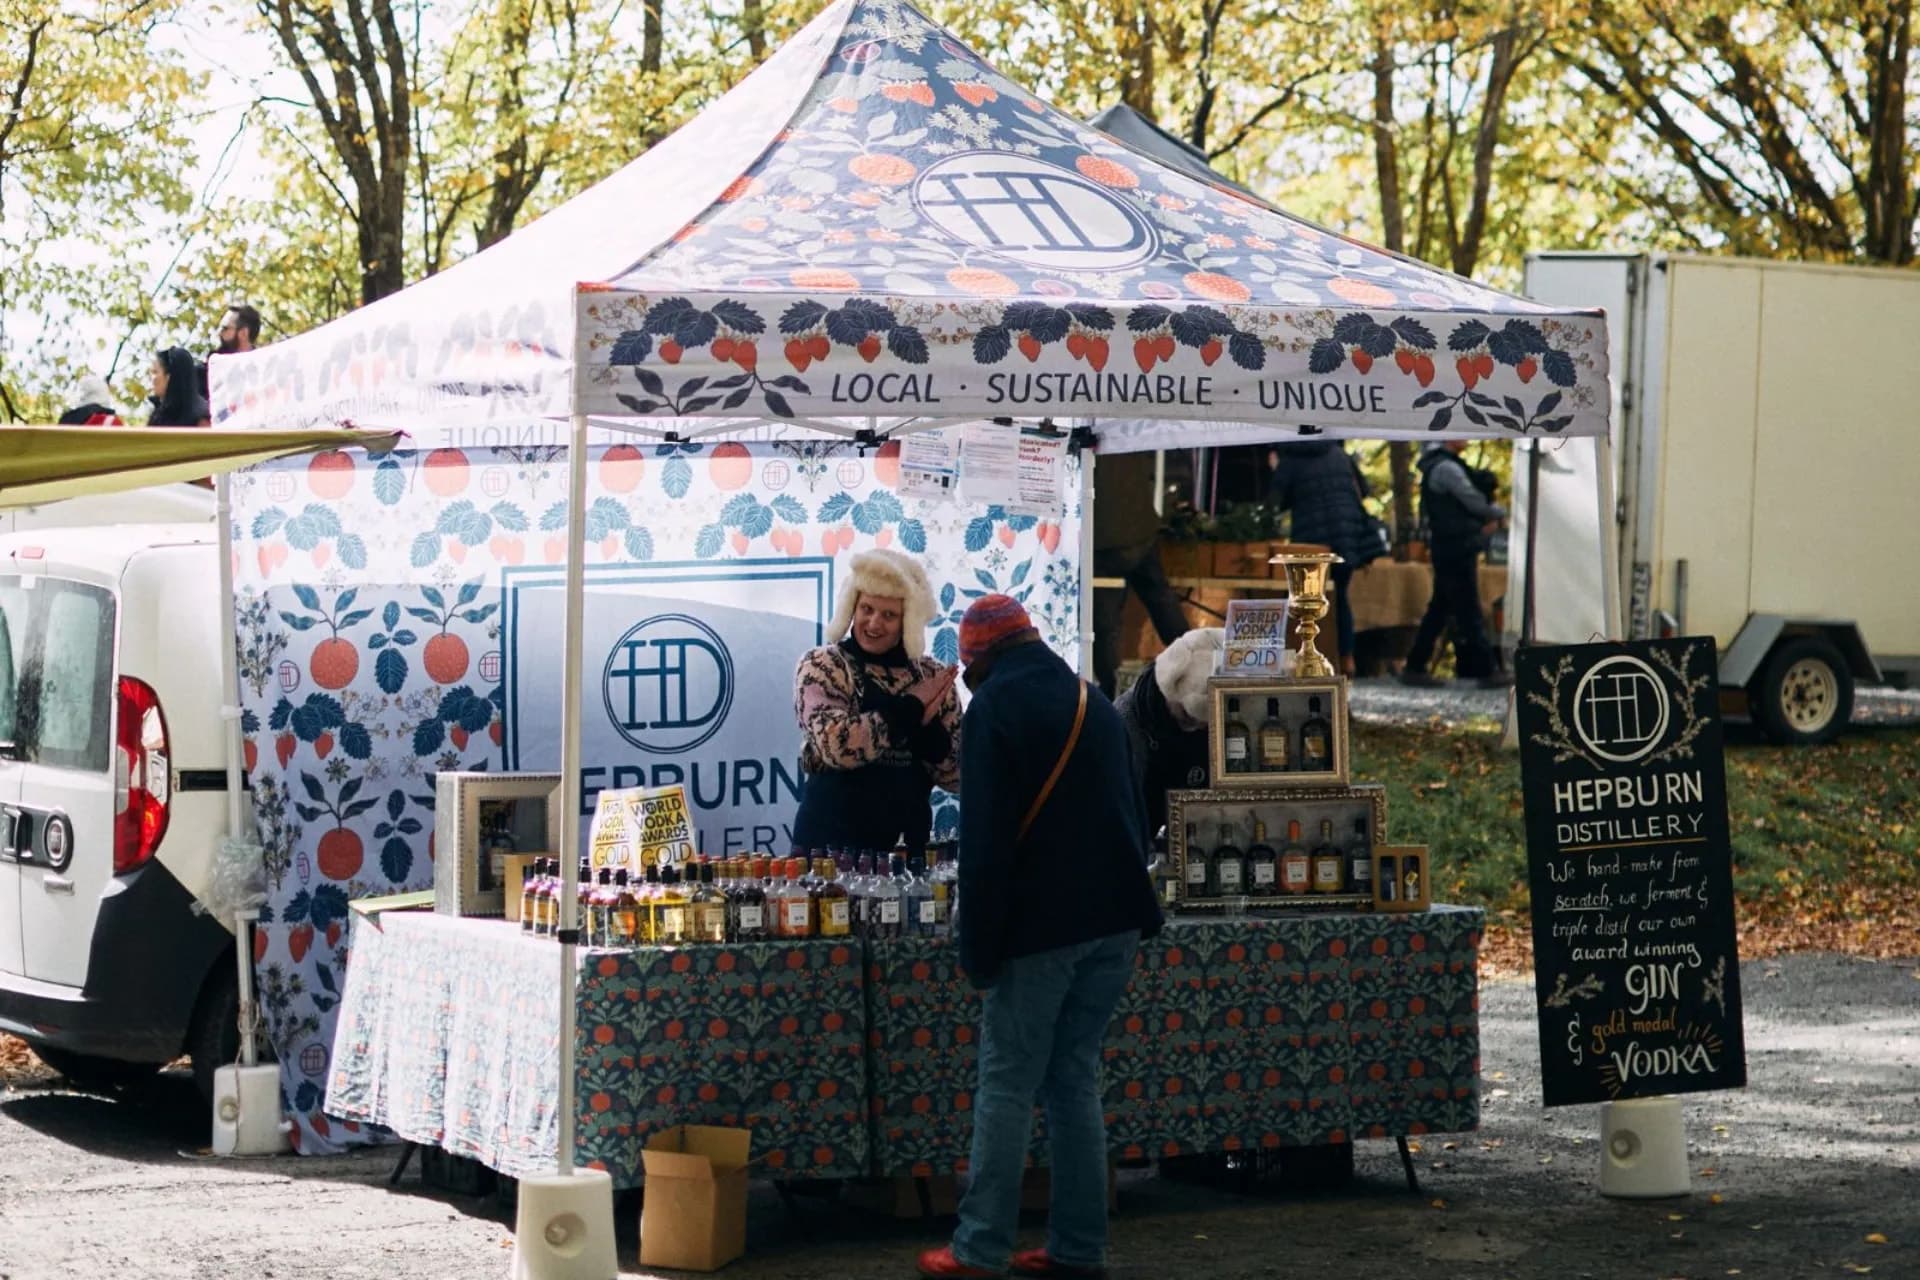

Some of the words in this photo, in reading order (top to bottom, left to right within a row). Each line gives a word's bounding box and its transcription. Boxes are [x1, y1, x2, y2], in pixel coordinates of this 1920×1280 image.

[831, 373, 941, 403] LOCAL
[986, 373, 1213, 406] SUSTAINABLE
[1259, 380, 1387, 413] UNIQUE
[1233, 624, 1277, 634] VODKA
[1229, 650, 1276, 667] GOLD
[1553, 770, 1703, 813] HEPBURN
[631, 798, 682, 816] WORLD
[635, 811, 686, 829] VODKA
[639, 825, 689, 842] AWARDS
[1557, 813, 1703, 843] DISTILLERY
[595, 844, 630, 865] GOLD
[641, 842, 692, 867] GOLD
[1547, 860, 1575, 882] We
[1668, 851, 1700, 882] from
[1619, 893, 1637, 905] we
[1642, 880, 1692, 910] ferment
[1552, 914, 1588, 946] triple
[1595, 913, 1630, 936] distil
[1638, 918, 1664, 932] our
[1670, 915, 1696, 929] own
[1572, 937, 1628, 961] award
[1634, 941, 1702, 968] winning
[1592, 1008, 1626, 1054] gold
[1632, 1006, 1676, 1033] medal
[1611, 1041, 1720, 1083] VODKA
